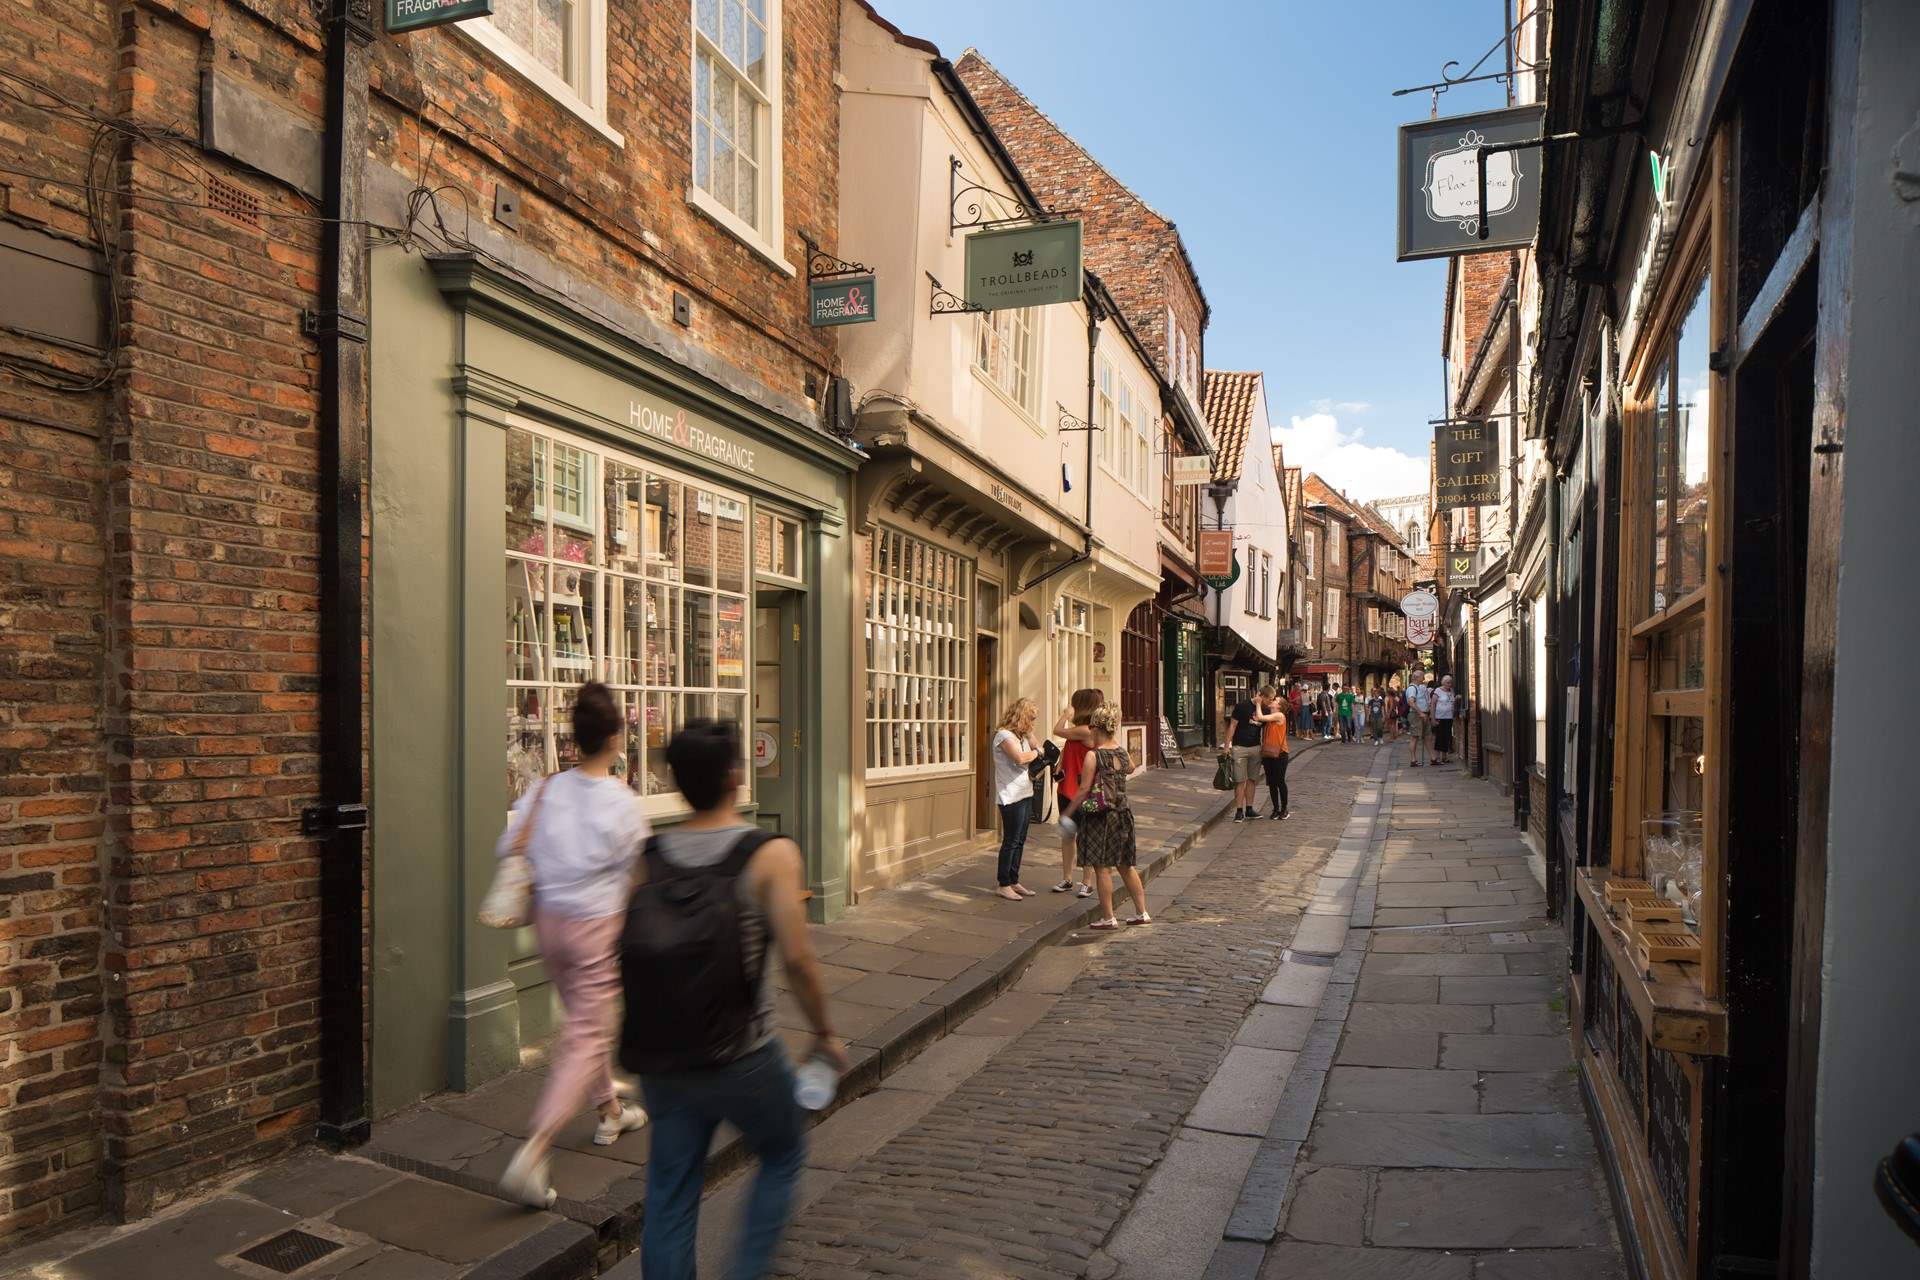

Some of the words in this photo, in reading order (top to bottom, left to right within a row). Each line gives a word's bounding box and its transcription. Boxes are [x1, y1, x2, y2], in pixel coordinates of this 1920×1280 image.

[397, 0, 472, 17] FRAGR
[1437, 174, 1466, 197] Flax
[980, 267, 1068, 288] TROLLBEADS
[816, 296, 845, 309] HOME
[845, 287, 867, 316] &
[816, 304, 869, 320] FRAGRANCE
[1452, 429, 1481, 441] THE
[1450, 451, 1484, 464] GIFT
[1436, 473, 1499, 488] GALLERY
[1437, 494, 1467, 504] 01904
